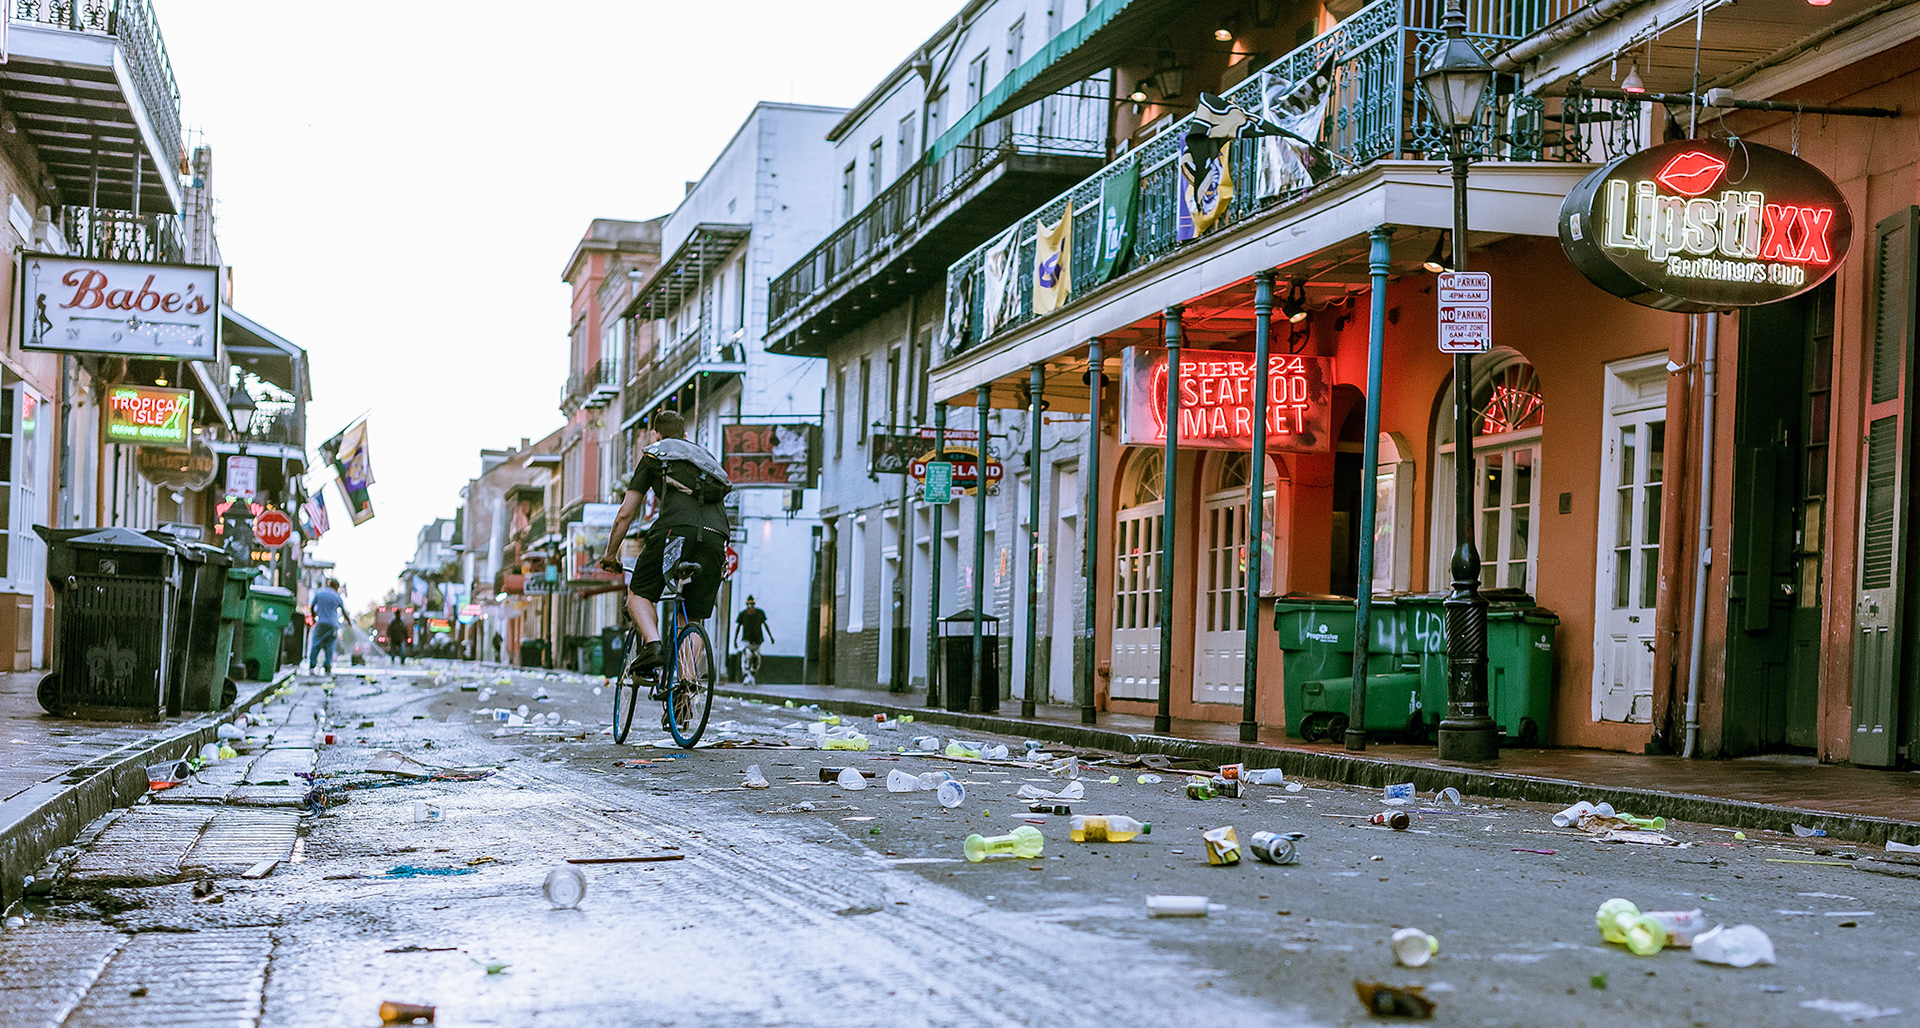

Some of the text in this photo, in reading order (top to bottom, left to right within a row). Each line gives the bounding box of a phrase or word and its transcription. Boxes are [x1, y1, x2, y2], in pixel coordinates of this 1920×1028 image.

[1440, 277, 1487, 288] NO PARKING
[59, 268, 211, 314] Babe's
[1440, 310, 1487, 321] NO PARKING
[1179, 361, 1250, 377] PIER
[1182, 375, 1308, 407] SEAFOD
[111, 396, 185, 414] TROPICAL
[133, 409, 164, 426] ISLE
[914, 464, 1000, 477] DELAD
[258, 521, 289, 538] STOP
[1306, 631, 1339, 641] Progressive
